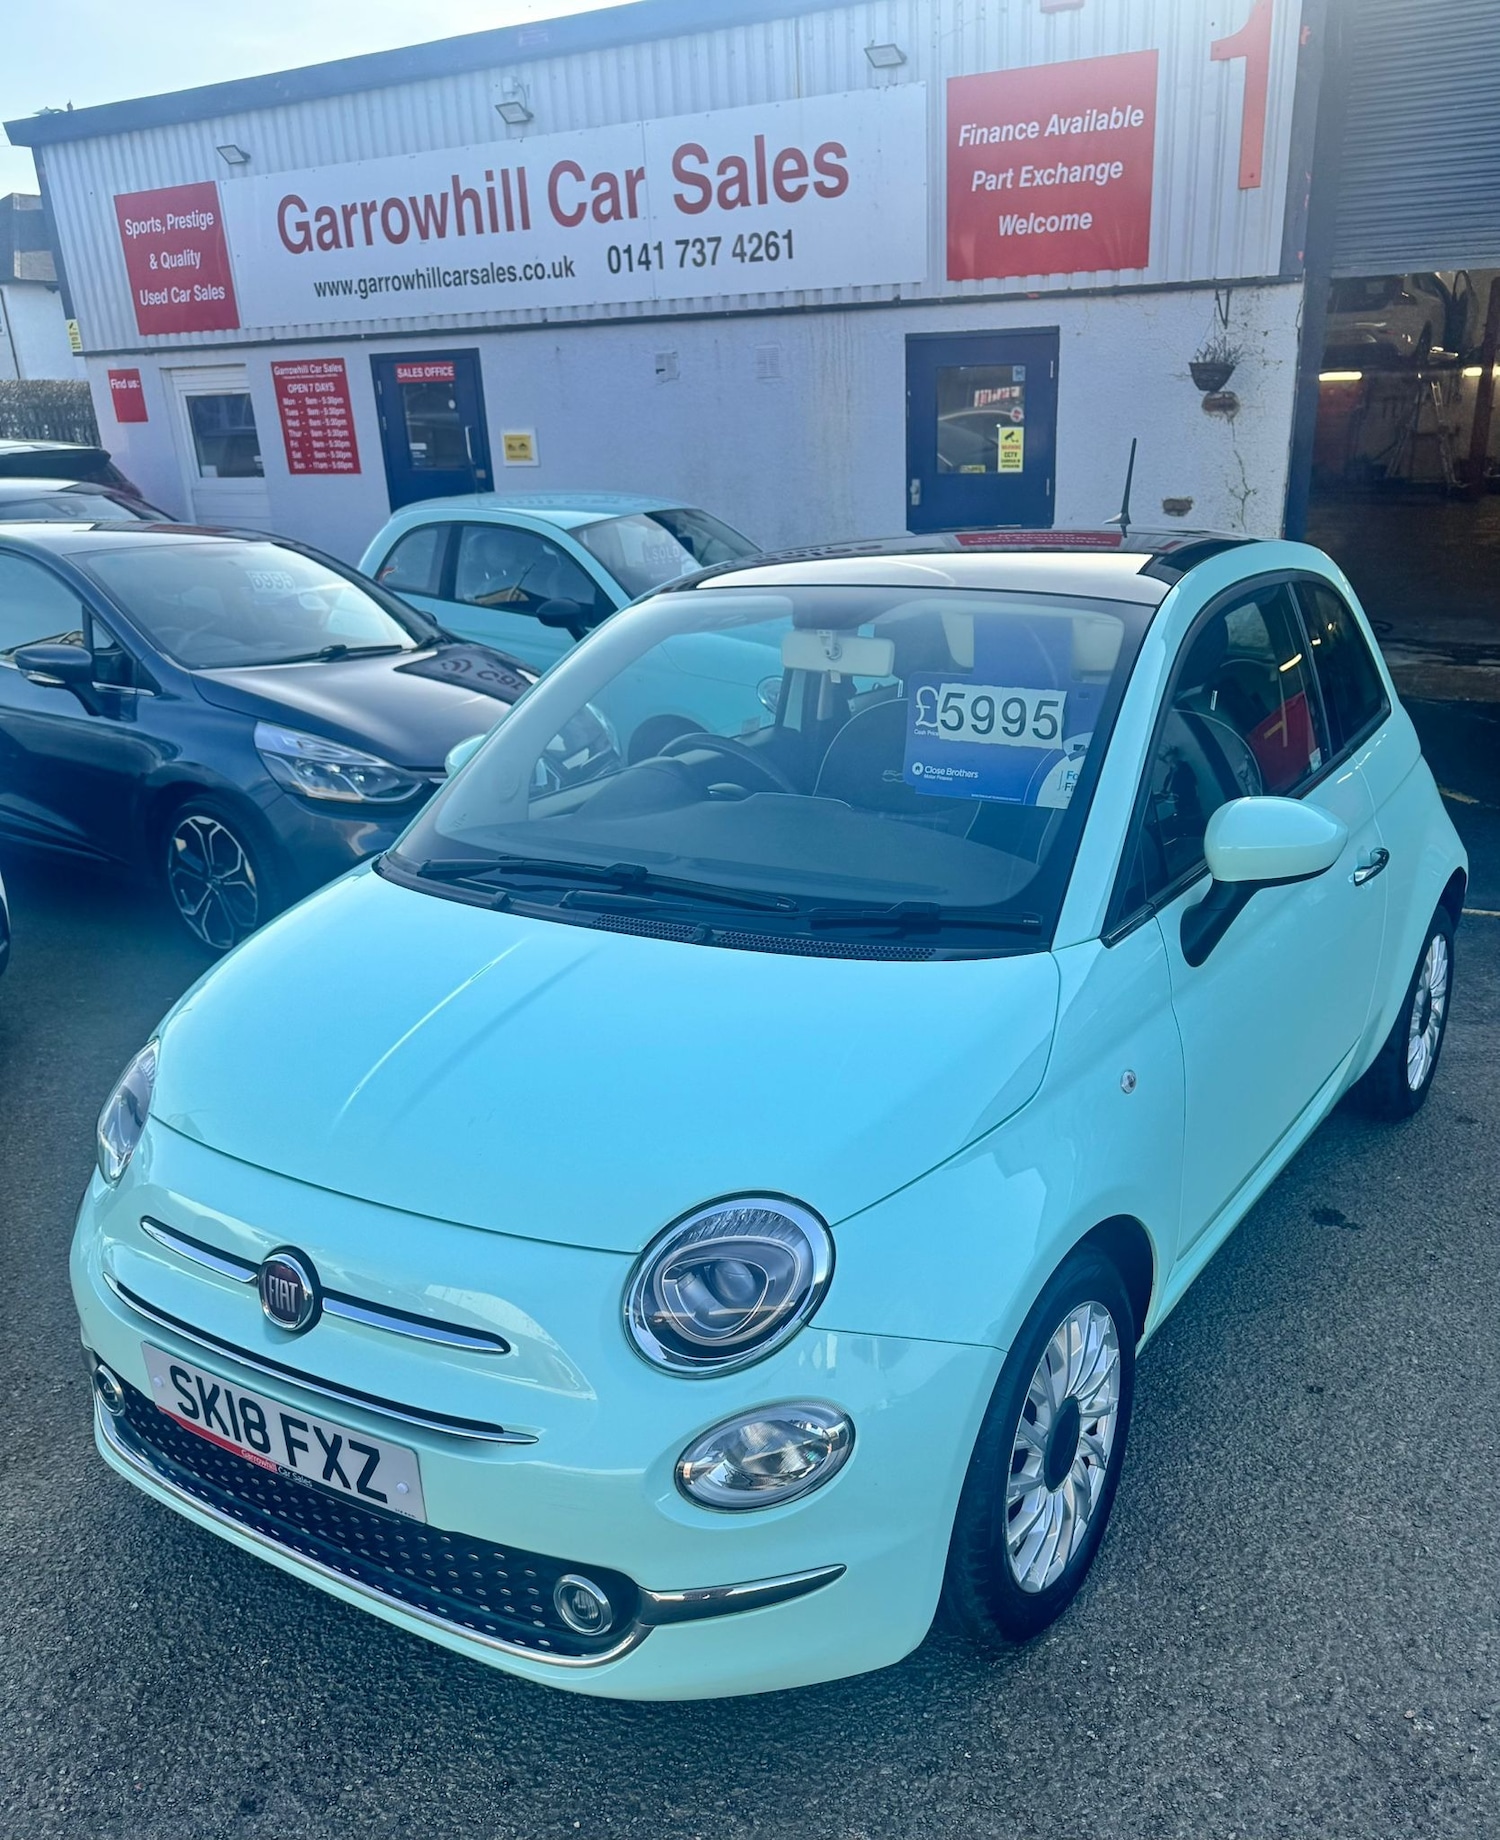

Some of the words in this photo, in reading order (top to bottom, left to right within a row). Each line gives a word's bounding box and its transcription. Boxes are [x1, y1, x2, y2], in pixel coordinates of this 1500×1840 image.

[958, 121, 1039, 147] Finance
[1044, 105, 1144, 137] Available
[971, 168, 1014, 192] Part
[1019, 161, 1123, 186] Exchange
[277, 166, 531, 254] Garrowhill
[548, 160, 645, 228] Car
[672, 134, 849, 214] Sales
[125, 217, 166, 239] Sports,
[167, 210, 214, 230] Prestige
[999, 211, 1093, 236] Welcome
[149, 253, 158, 270] &
[160, 249, 201, 269] Quality
[607, 241, 664, 274] 0141
[675, 236, 722, 268] 737
[732, 229, 794, 264] 4261
[314, 255, 575, 299] www.garrowhillcarsales.co.uk
[140, 288, 168, 305] Used
[171, 287, 191, 303] Car
[193, 284, 225, 301] Sales
[310, 364, 322, 374] Car
[323, 363, 343, 373] Sales
[397, 368, 424, 378] SALES
[424, 366, 455, 377] OFFICE
[110, 379, 126, 389] Find
[287, 383, 309, 393] OPEN
[315, 382, 335, 392] DAYS
[924, 765, 945, 775] Close
[946, 767, 978, 779] Brothers
[268, 1275, 299, 1314] FIAT
[170, 1365, 271, 1454] SK18
[280, 1412, 388, 1504] FXZ
[241, 1449, 278, 1472] Garrowhill
[278, 1466, 291, 1477] Car
[292, 1472, 313, 1488] Sales
